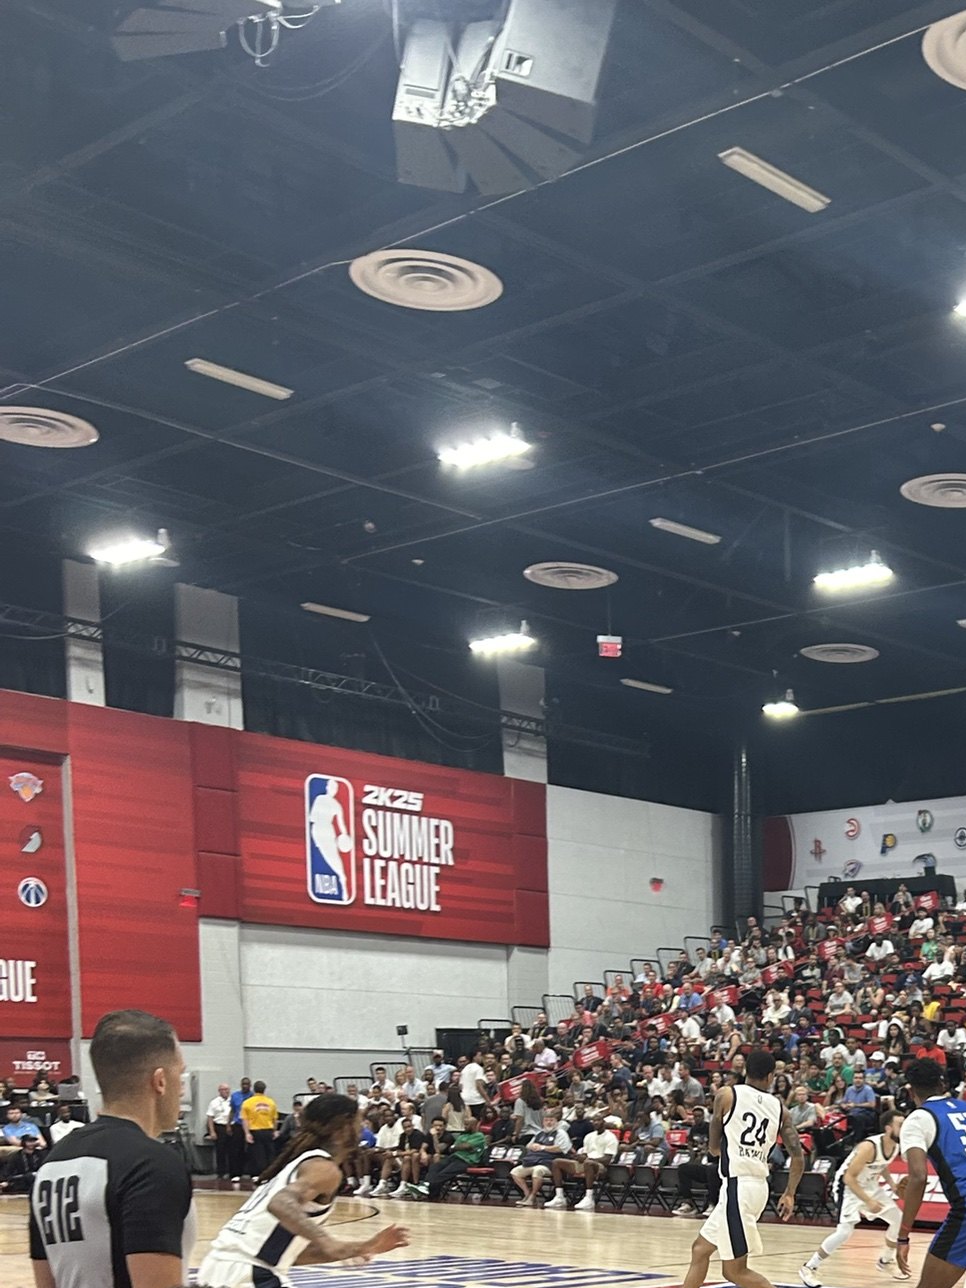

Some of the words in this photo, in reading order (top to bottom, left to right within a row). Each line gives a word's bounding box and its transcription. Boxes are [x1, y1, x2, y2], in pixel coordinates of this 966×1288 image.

[361, 785, 424, 811] 2K25
[362, 808, 455, 866] SUMMER
[314, 873, 339, 896] NBA
[362, 858, 442, 912] LEAGUE
[12, 1060, 61, 1071] TISSOT
[740, 1111, 770, 1147] 24
[38, 1174, 85, 1246] 212
